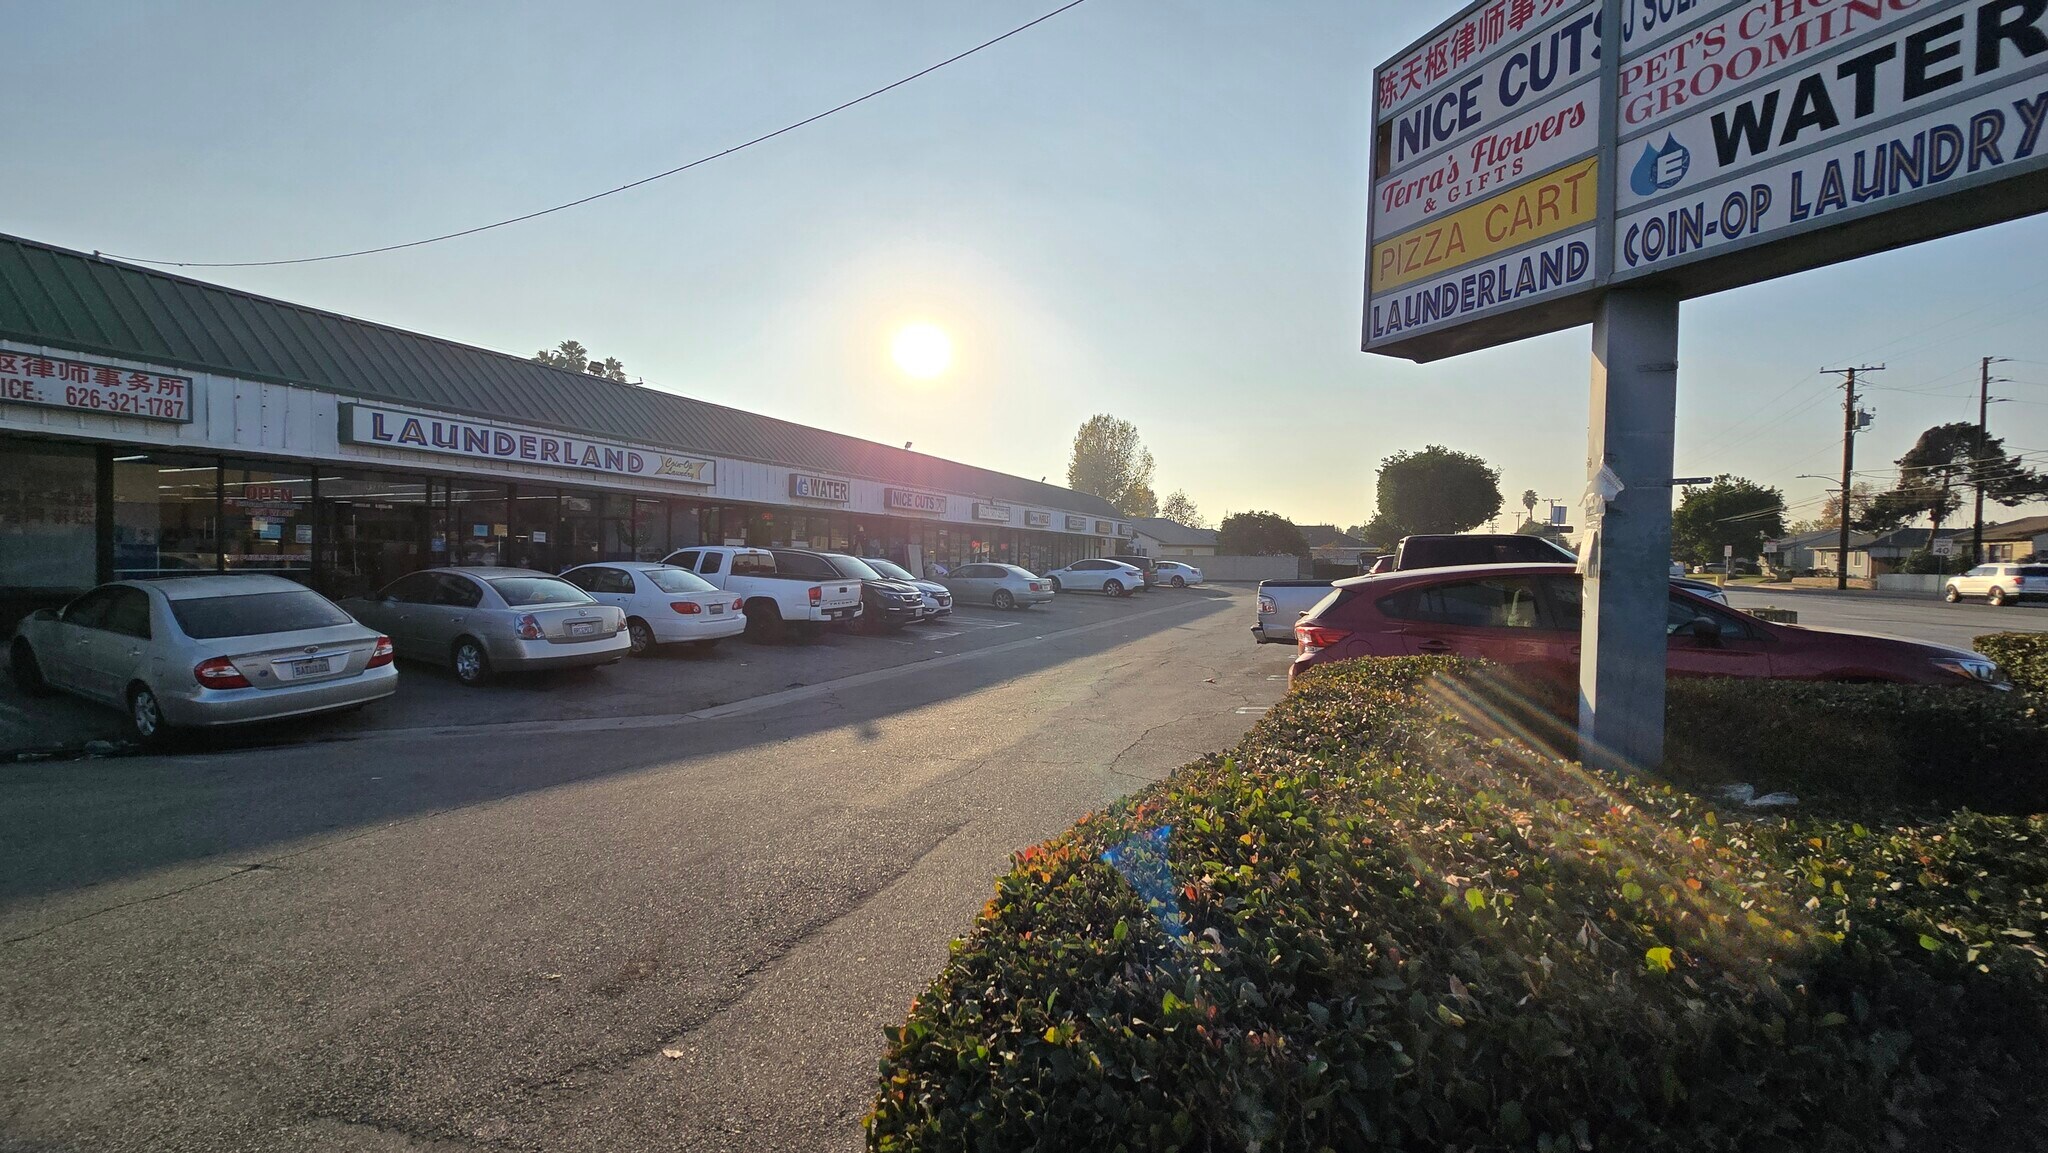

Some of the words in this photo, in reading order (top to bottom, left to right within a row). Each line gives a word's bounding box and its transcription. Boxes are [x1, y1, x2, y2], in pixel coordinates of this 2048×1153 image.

[1379, 0, 1566, 109] 陈天枢律师事
[1619, 24, 1726, 97] PET'S
[1738, 0, 1828, 40] CH
[1625, 0, 1921, 124] GROOMIN
[1710, 0, 2048, 167] WATER
[1382, 155, 1460, 214] Terra's
[1471, 101, 1586, 174] Flowers
[1398, 74, 1484, 163] NICE
[1380, 222, 1466, 281] PIZZA
[1485, 170, 1589, 243] CART
[1424, 198, 1437, 214] &
[1448, 157, 1523, 203] GIFTS
[1624, 183, 1772, 267] COIN-OP
[1789, 91, 2048, 222] LAUNDRY
[1373, 241, 1589, 339] LAUNDERLAND
[65, 386, 184, 418] 626-321-1787
[371, 412, 645, 473] LAUNDERLAND
[245, 486, 293, 502] OPEN
[810, 478, 847, 500] WATER
[893, 491, 912, 507] NICE
[915, 495, 935, 510] CUTS
[1935, 547, 1950, 555] 40
